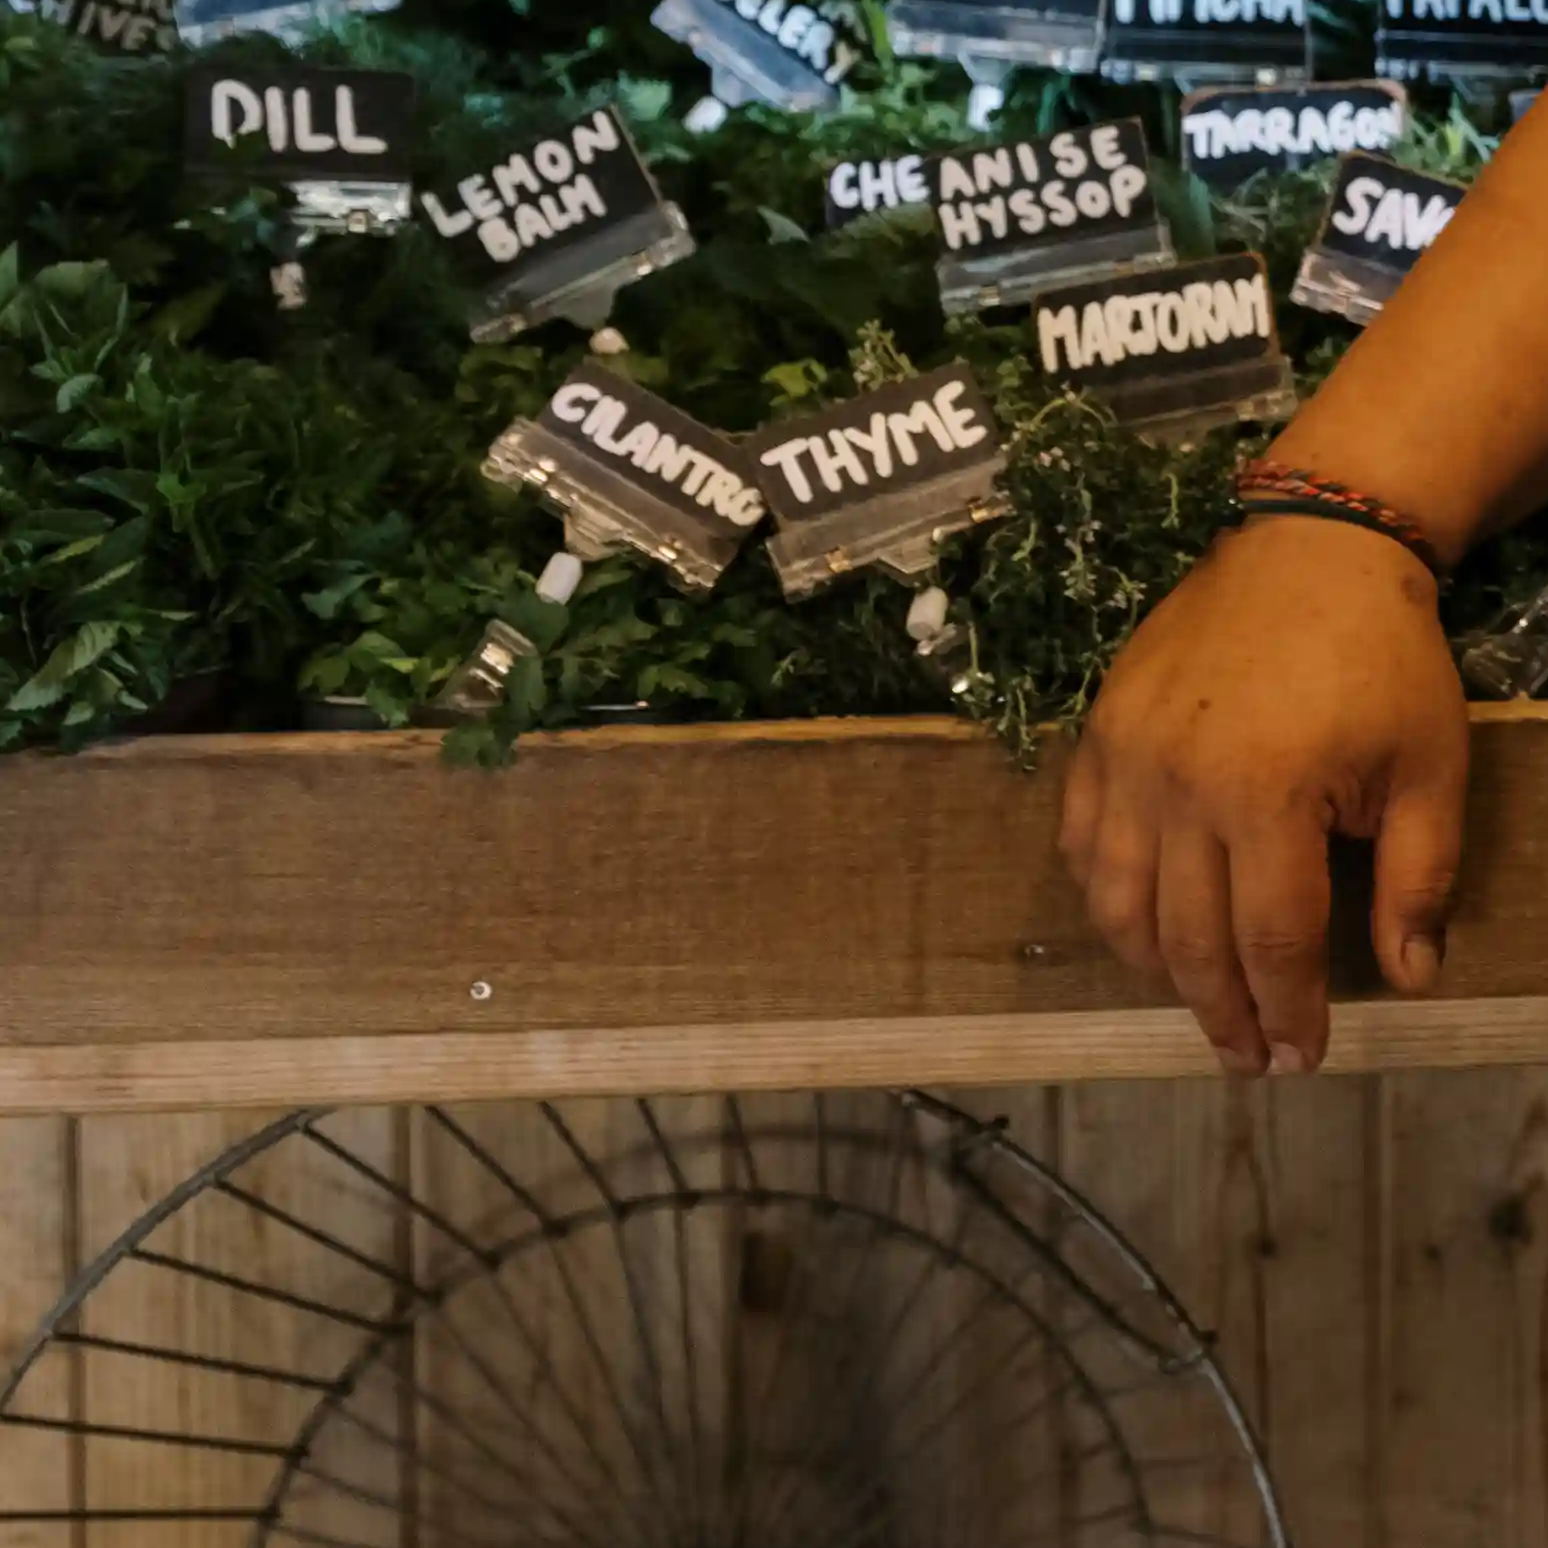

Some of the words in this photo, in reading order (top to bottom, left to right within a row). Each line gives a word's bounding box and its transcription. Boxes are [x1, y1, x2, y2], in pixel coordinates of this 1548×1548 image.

[210, 78, 388, 154] DILL
[1181, 100, 1403, 160] TARRAGON
[420, 109, 621, 238] LEMON
[936, 164, 1148, 249] HYSSOP
[938, 124, 1127, 202] ANISE
[477, 174, 606, 263] BALM
[1036, 274, 1270, 374] MARJORAM
[551, 382, 765, 526] CILANTRO
[760, 379, 988, 504] THYME
